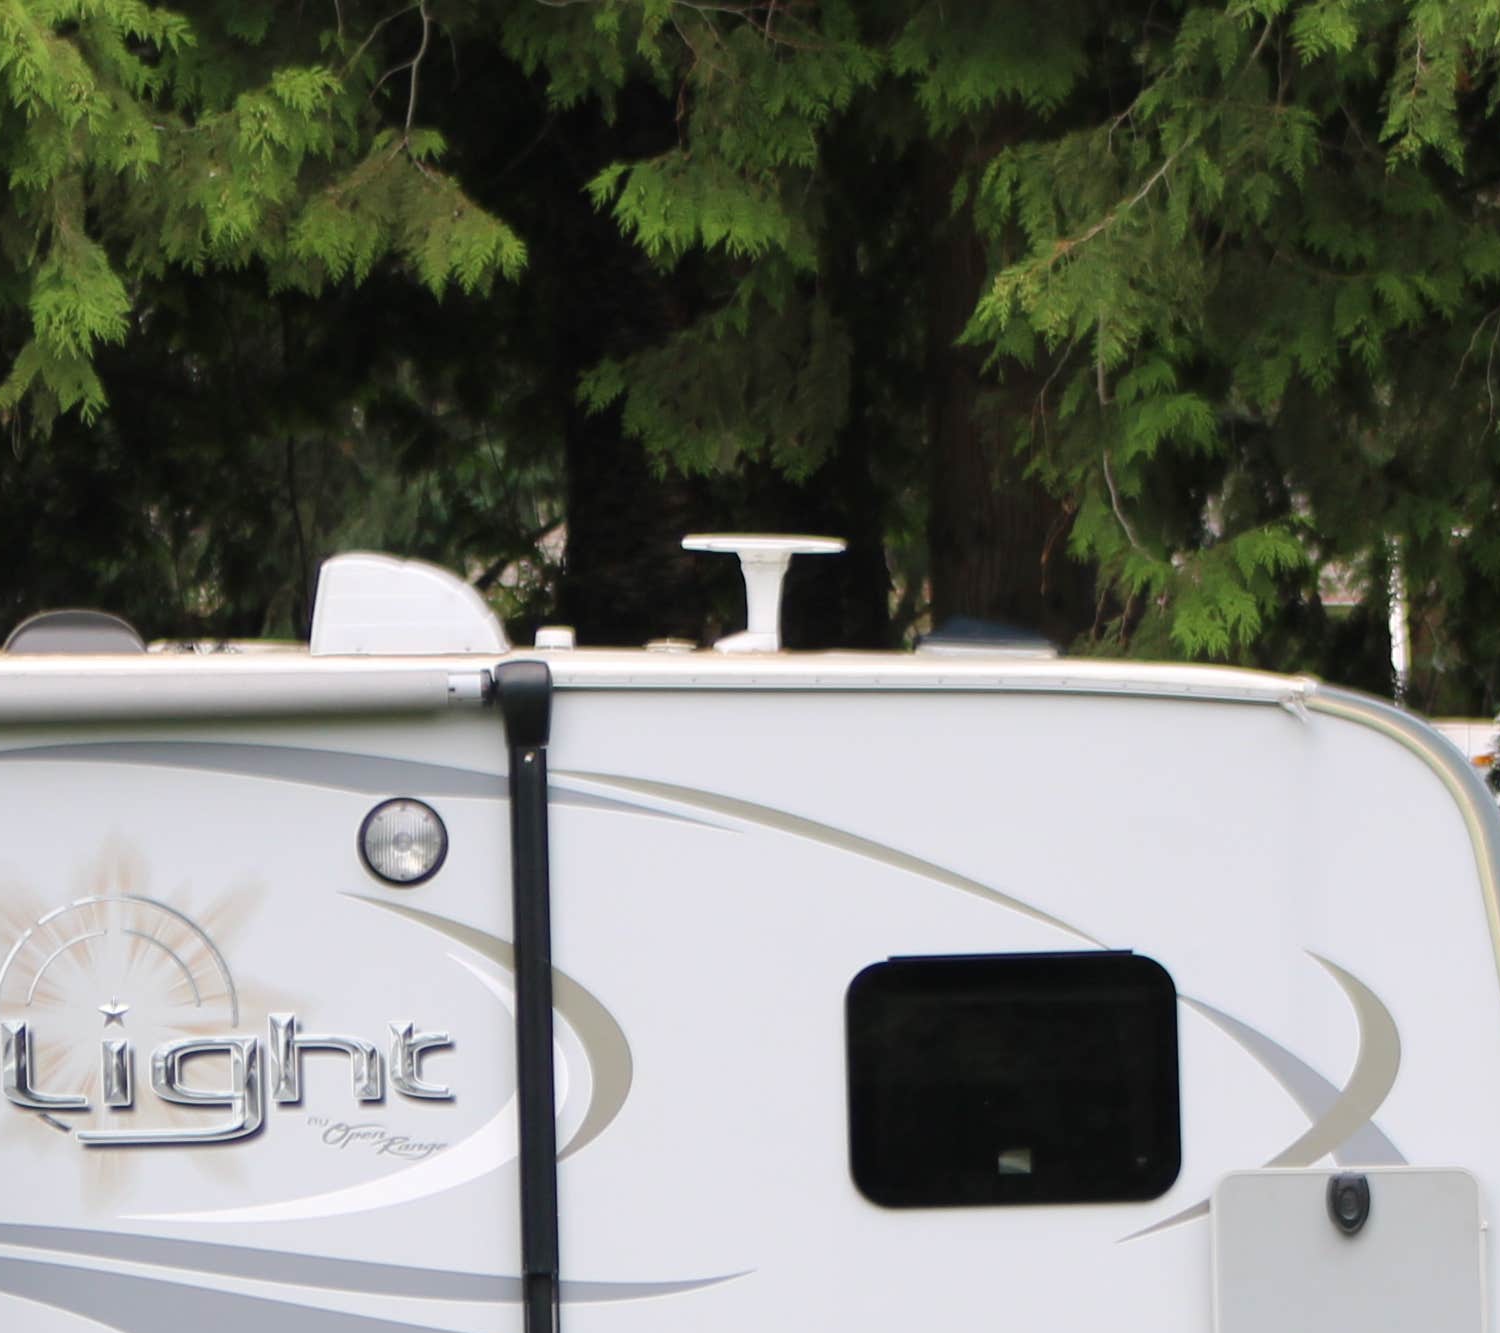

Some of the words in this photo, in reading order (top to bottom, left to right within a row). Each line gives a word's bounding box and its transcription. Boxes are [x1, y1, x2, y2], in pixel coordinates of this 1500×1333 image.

[1, 1012, 457, 1146] Light
[322, 1122, 388, 1150] Open
[373, 1136, 448, 1161] Range
